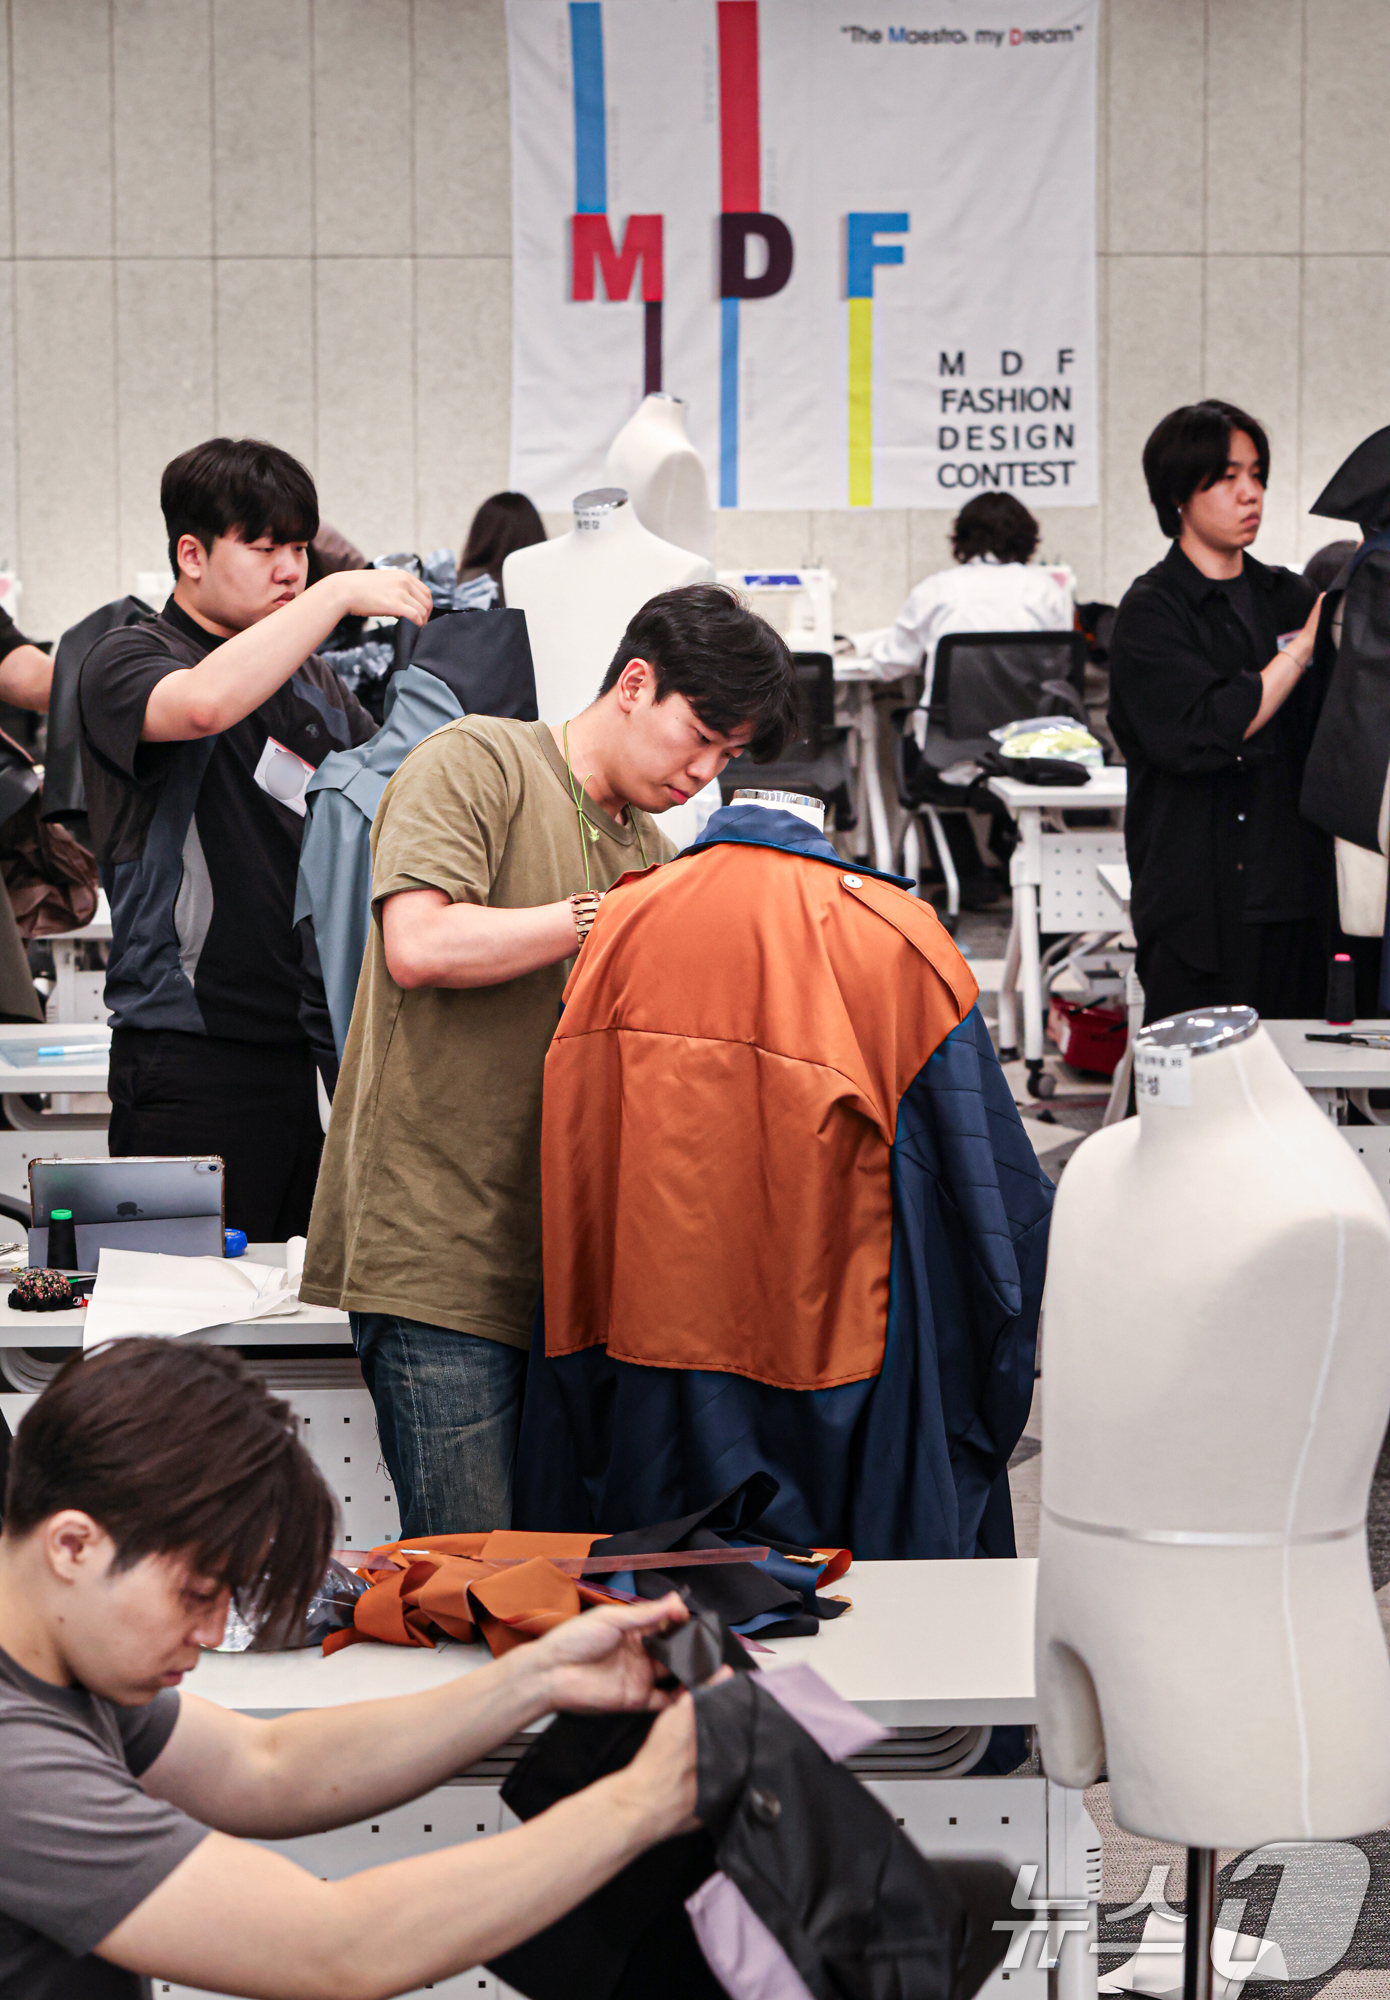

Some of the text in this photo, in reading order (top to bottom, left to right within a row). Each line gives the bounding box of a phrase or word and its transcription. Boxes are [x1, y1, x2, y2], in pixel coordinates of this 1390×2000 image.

[975, 28, 1005, 47] my
[941, 386, 1071, 413] FASHION
[938, 424, 1073, 451] DESIGN
[937, 460, 1076, 488] CONTEST
